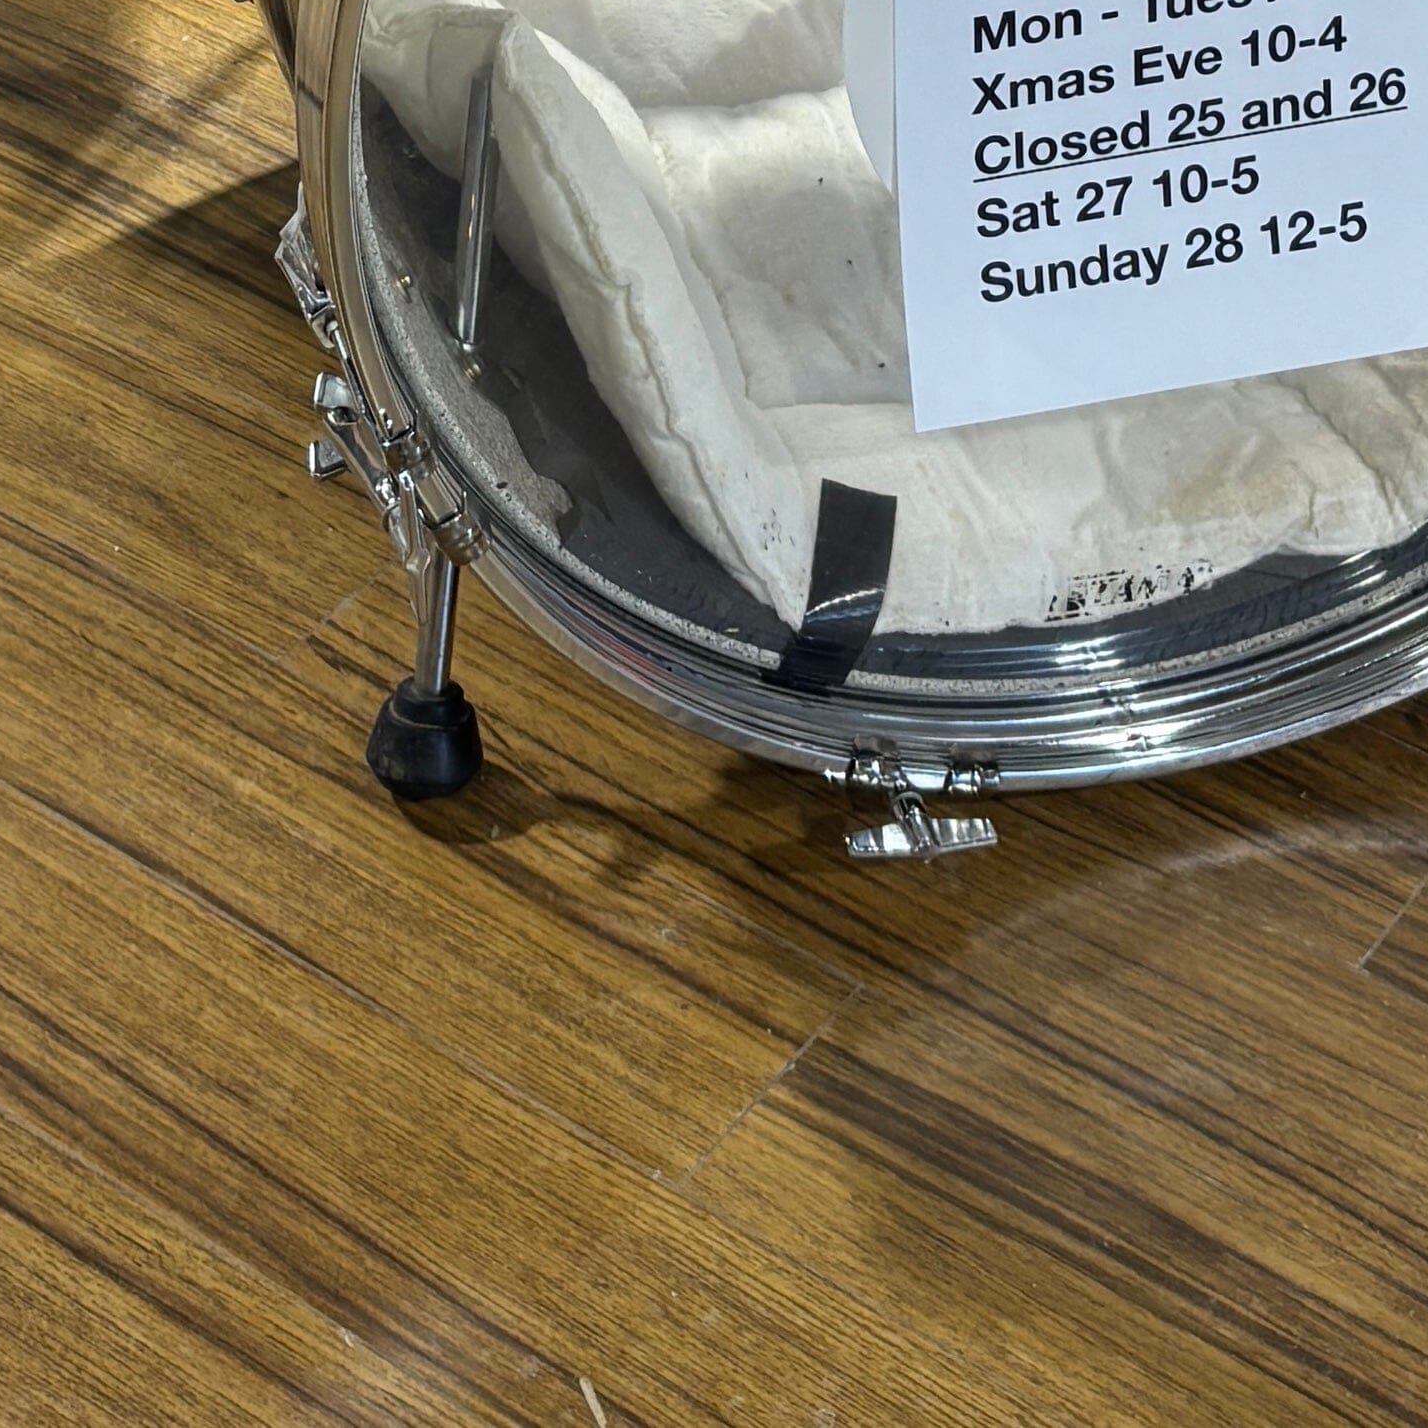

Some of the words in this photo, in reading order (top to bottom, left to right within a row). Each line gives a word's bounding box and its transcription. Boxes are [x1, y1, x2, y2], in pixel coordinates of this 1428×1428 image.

[972, 70, 1115, 115] Xmas
[1133, 46, 1223, 87] Eve
[1241, 15, 1348, 67] 10-4
[973, 8, 1082, 54] Mon
[974, 110, 1150, 176] Closed
[1167, 97, 1226, 143] 25
[1242, 79, 1332, 130] and
[1349, 67, 1406, 113] 26
[977, 190, 1061, 238] Sat
[1076, 176, 1133, 223] 27
[1152, 154, 1260, 208] 10-5
[980, 244, 1169, 303] Sunday
[1185, 223, 1244, 269] 28
[1260, 201, 1368, 255] 12-5
